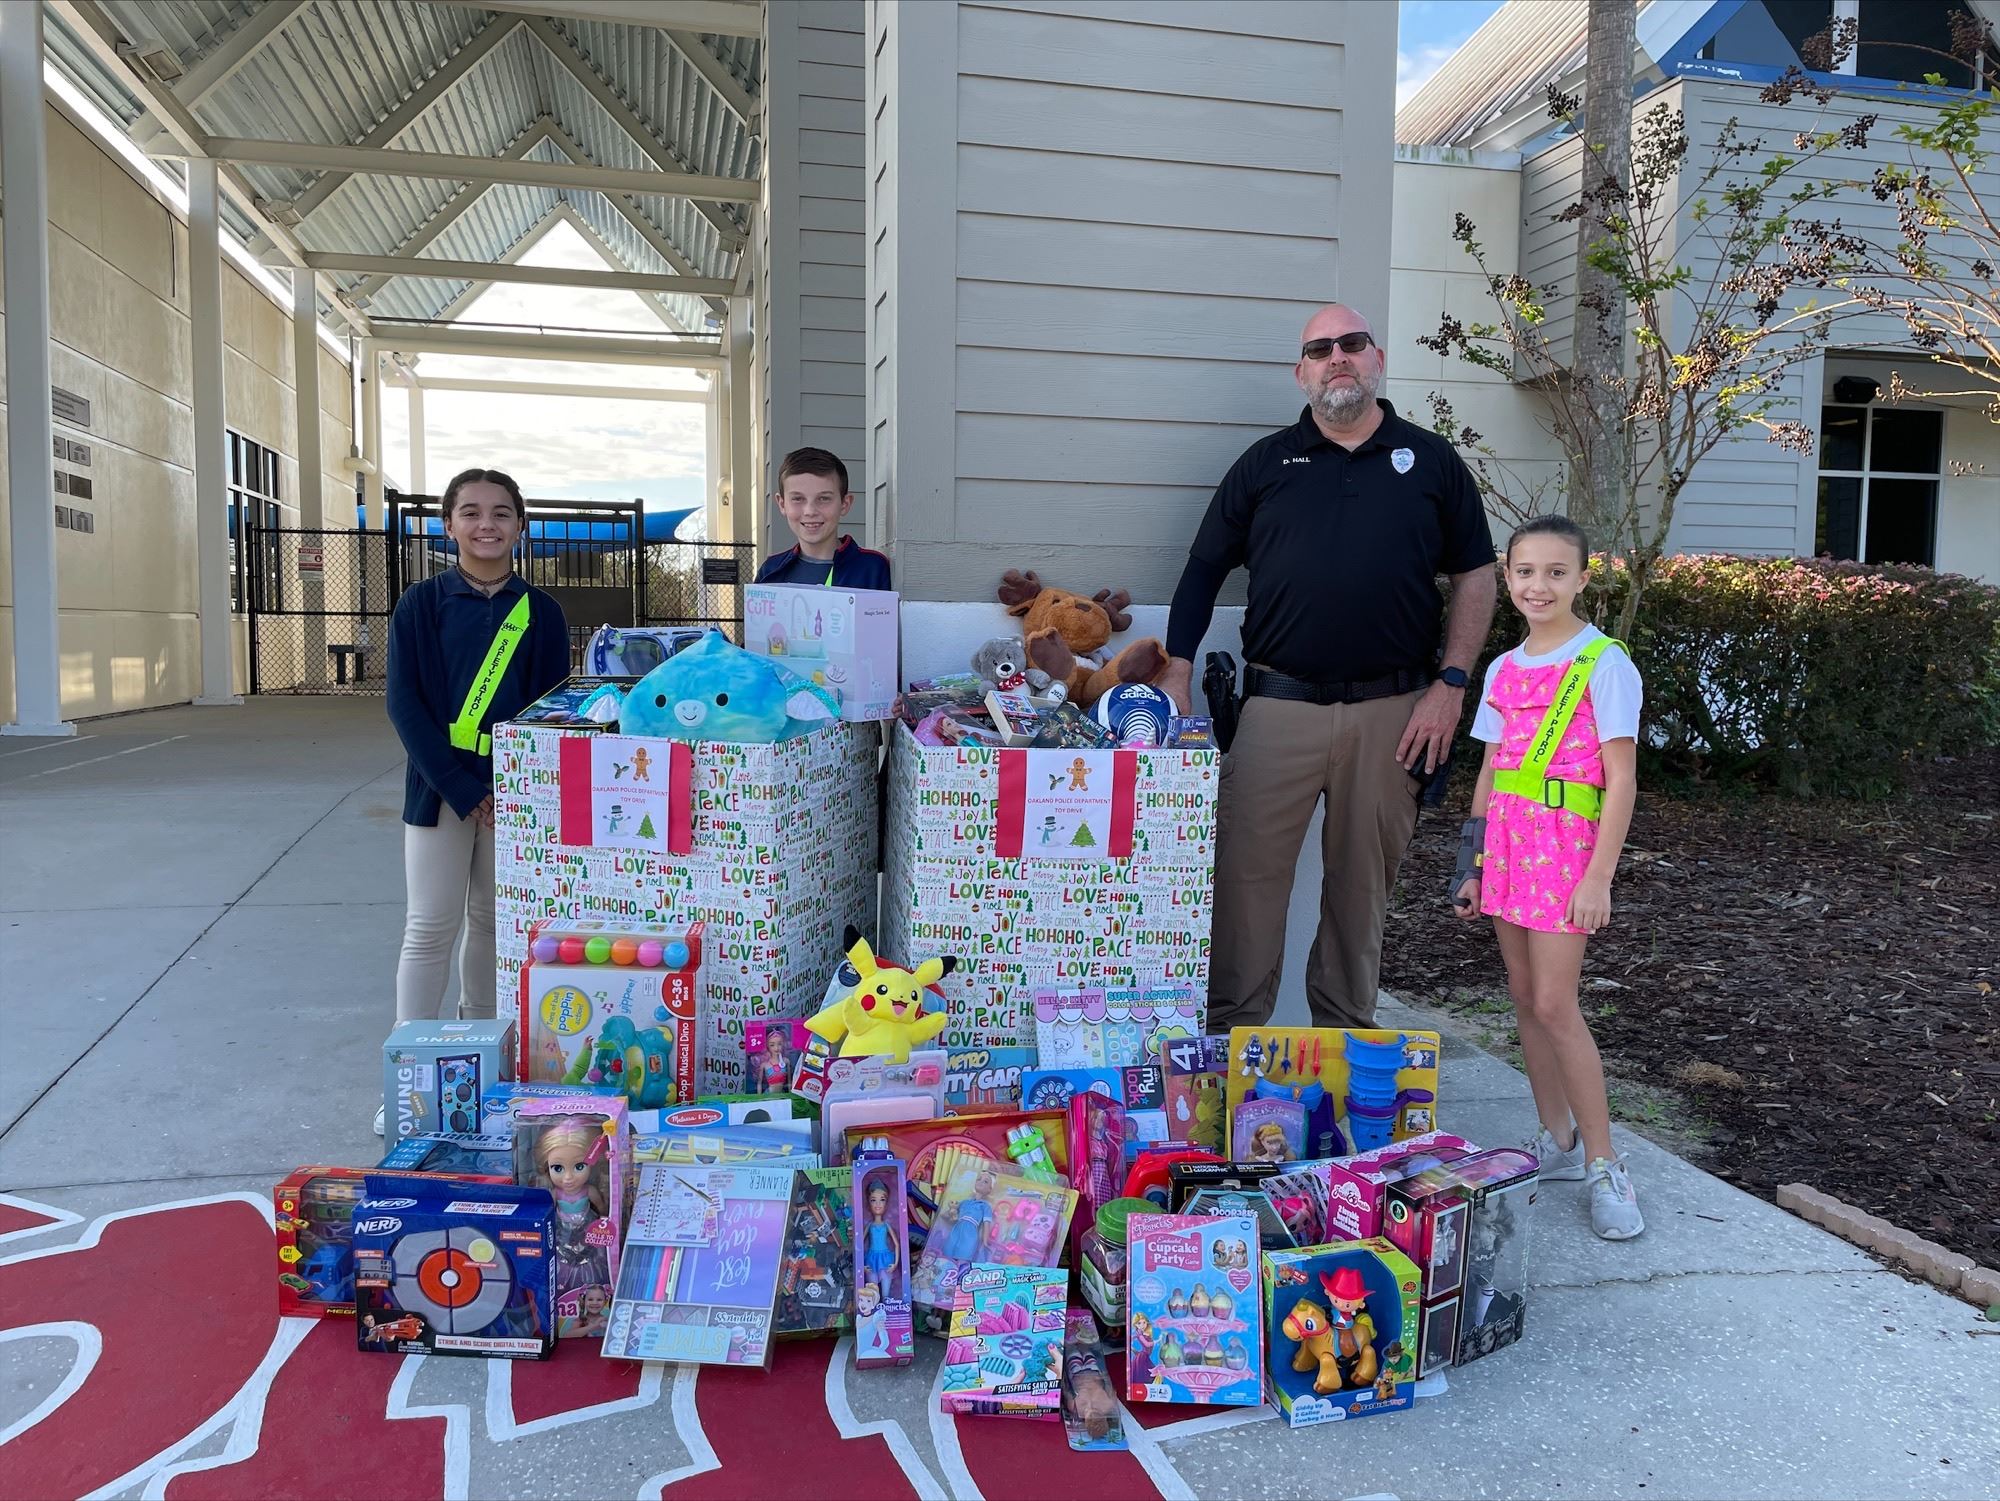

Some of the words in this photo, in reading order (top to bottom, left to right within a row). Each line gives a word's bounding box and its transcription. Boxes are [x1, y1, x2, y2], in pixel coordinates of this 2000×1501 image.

[746, 589, 777, 600] PERFECTLY
[487, 639, 509, 677] SAFETY
[468, 677, 491, 717] PATROL
[1120, 690, 1161, 703] adidas
[1554, 673, 1580, 717] SAFETY
[505, 729, 531, 740] HOHO
[1533, 719, 1558, 763] PATROL
[712, 744, 742, 754] HOHO
[503, 752, 524, 774] JOY
[699, 755, 715, 766] noel
[709, 768, 732, 789] JOY
[639, 788, 668, 797] DEPARTMENT
[742, 785, 786, 800] HOHOHO
[920, 791, 980, 807] HOHOHO
[1146, 793, 1203, 808] HOHOHO
[516, 846, 553, 864] LOVE
[614, 857, 655, 875] LOVE
[659, 864, 687, 876] HOHO
[722, 866, 765, 885] LOVE
[950, 884, 995, 899] LOVE
[584, 895, 637, 915] HOHOHO
[688, 907, 744, 927] HOHOHO
[620, 978, 637, 1014] yippee!
[672, 978, 683, 1008] 6-36
[1038, 995, 1068, 1005] HELLO
[1069, 994, 1101, 1004] KITTY
[1106, 991, 1141, 1001] SUPER
[1143, 989, 1192, 1000] ACTIVITY
[415, 1034, 496, 1043] MOVING
[679, 1022, 690, 1040] Dino
[680, 1041, 690, 1076] Musical
[946, 1050, 990, 1071] METRO
[1169, 1042, 1199, 1072] 4
[1197, 1039, 1206, 1068] Puzzles
[1125, 1067, 1146, 1109] look
[1140, 1067, 1156, 1093] my
[749, 1176, 789, 1190] PLANNER
[363, 1198, 411, 1209] NERF
[723, 1200, 765, 1226] ever
[354, 1217, 399, 1235] NERF
[598, 1217, 608, 1229] 3
[584, 1238, 613, 1246] COLLECT!
[715, 1223, 758, 1256] day
[1148, 1241, 1199, 1256] Cupcake
[1153, 1252, 1186, 1267] Party
[710, 1255, 751, 1292] best
[876, 1302, 911, 1313] PRINCESS
[967, 1307, 975, 1316] 2
[714, 1311, 766, 1329] happiness
[438, 1338, 458, 1346] STRIKE
[493, 1341, 516, 1349] DIGITAL
[517, 1342, 539, 1350] TARGET
[977, 1337, 985, 1347] 2
[998, 1383, 1031, 1394] SATISFYING
[1032, 1381, 1048, 1390] SAND
[1049, 1380, 1059, 1388] KIT
[1295, 1416, 1319, 1424] Cowboy
